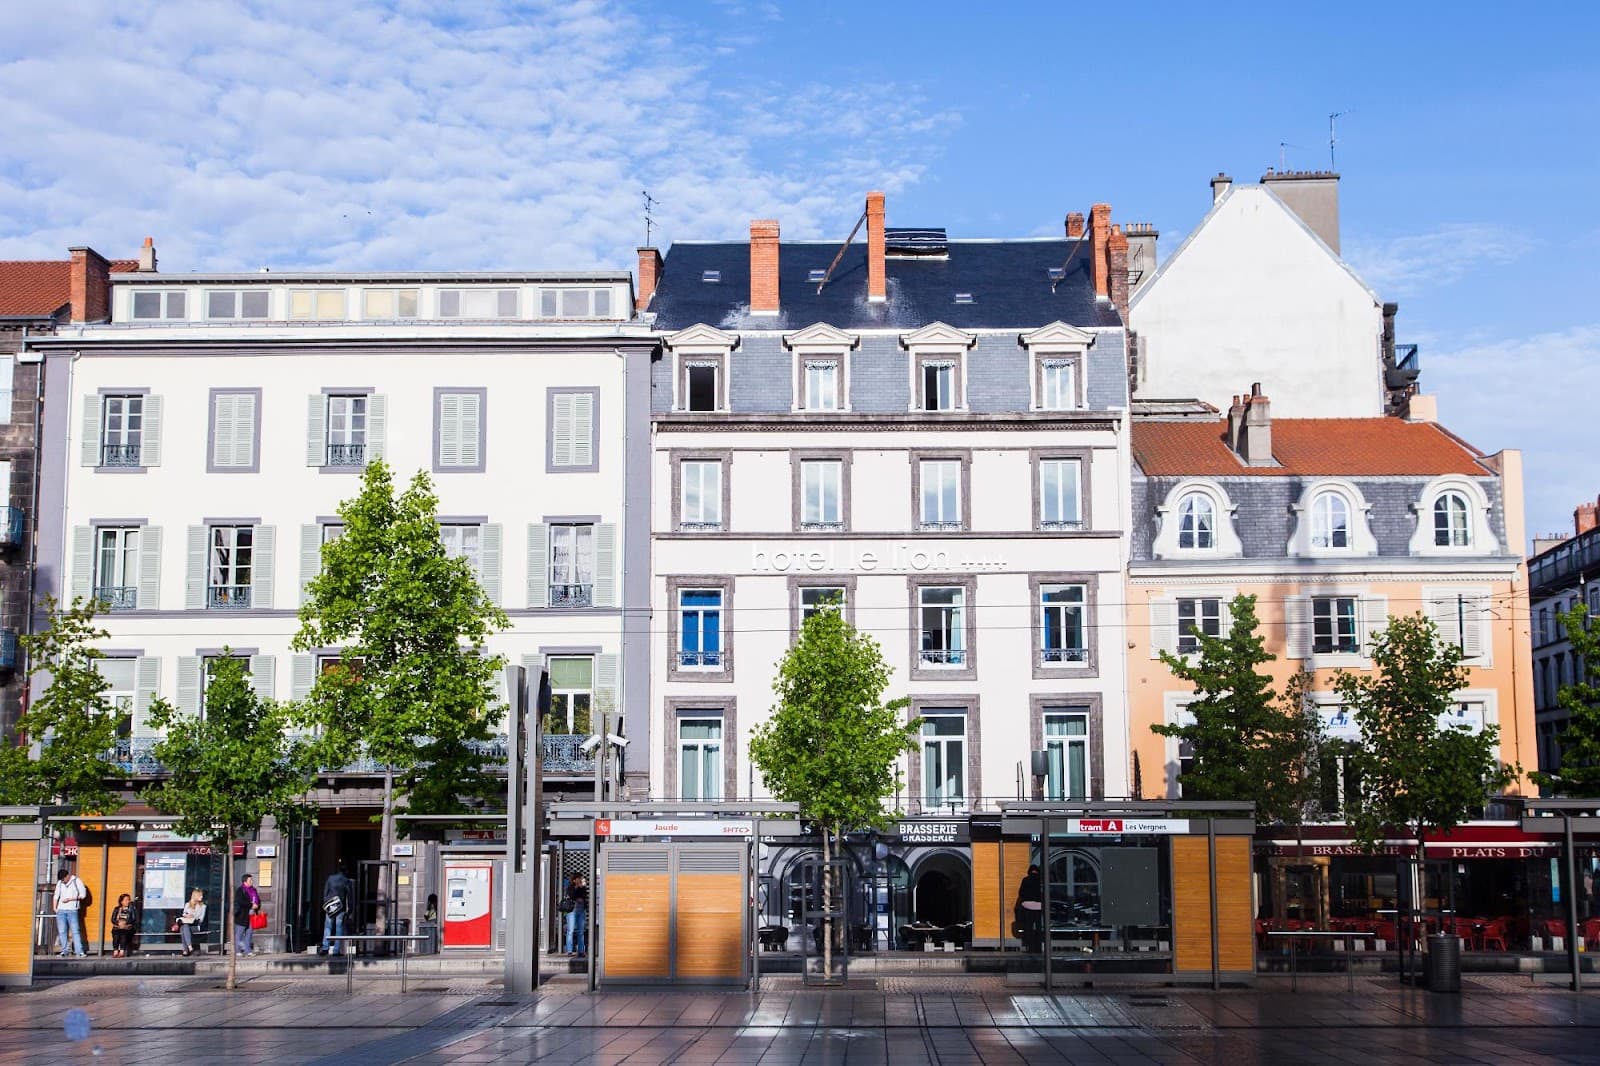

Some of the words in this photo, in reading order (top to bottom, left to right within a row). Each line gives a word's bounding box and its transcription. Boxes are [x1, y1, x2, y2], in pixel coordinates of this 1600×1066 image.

[752, 542, 834, 571] hotel
[850, 542, 878, 571] le
[893, 542, 950, 571] lion
[899, 824, 958, 834] BRASSERIE
[1080, 822, 1102, 831] tram
[1107, 820, 1117, 831] A
[1125, 823, 1137, 831] Les
[1139, 823, 1167, 832] Vergnes
[1451, 847, 1506, 858] PLATS
[1519, 847, 1544, 857] DU
